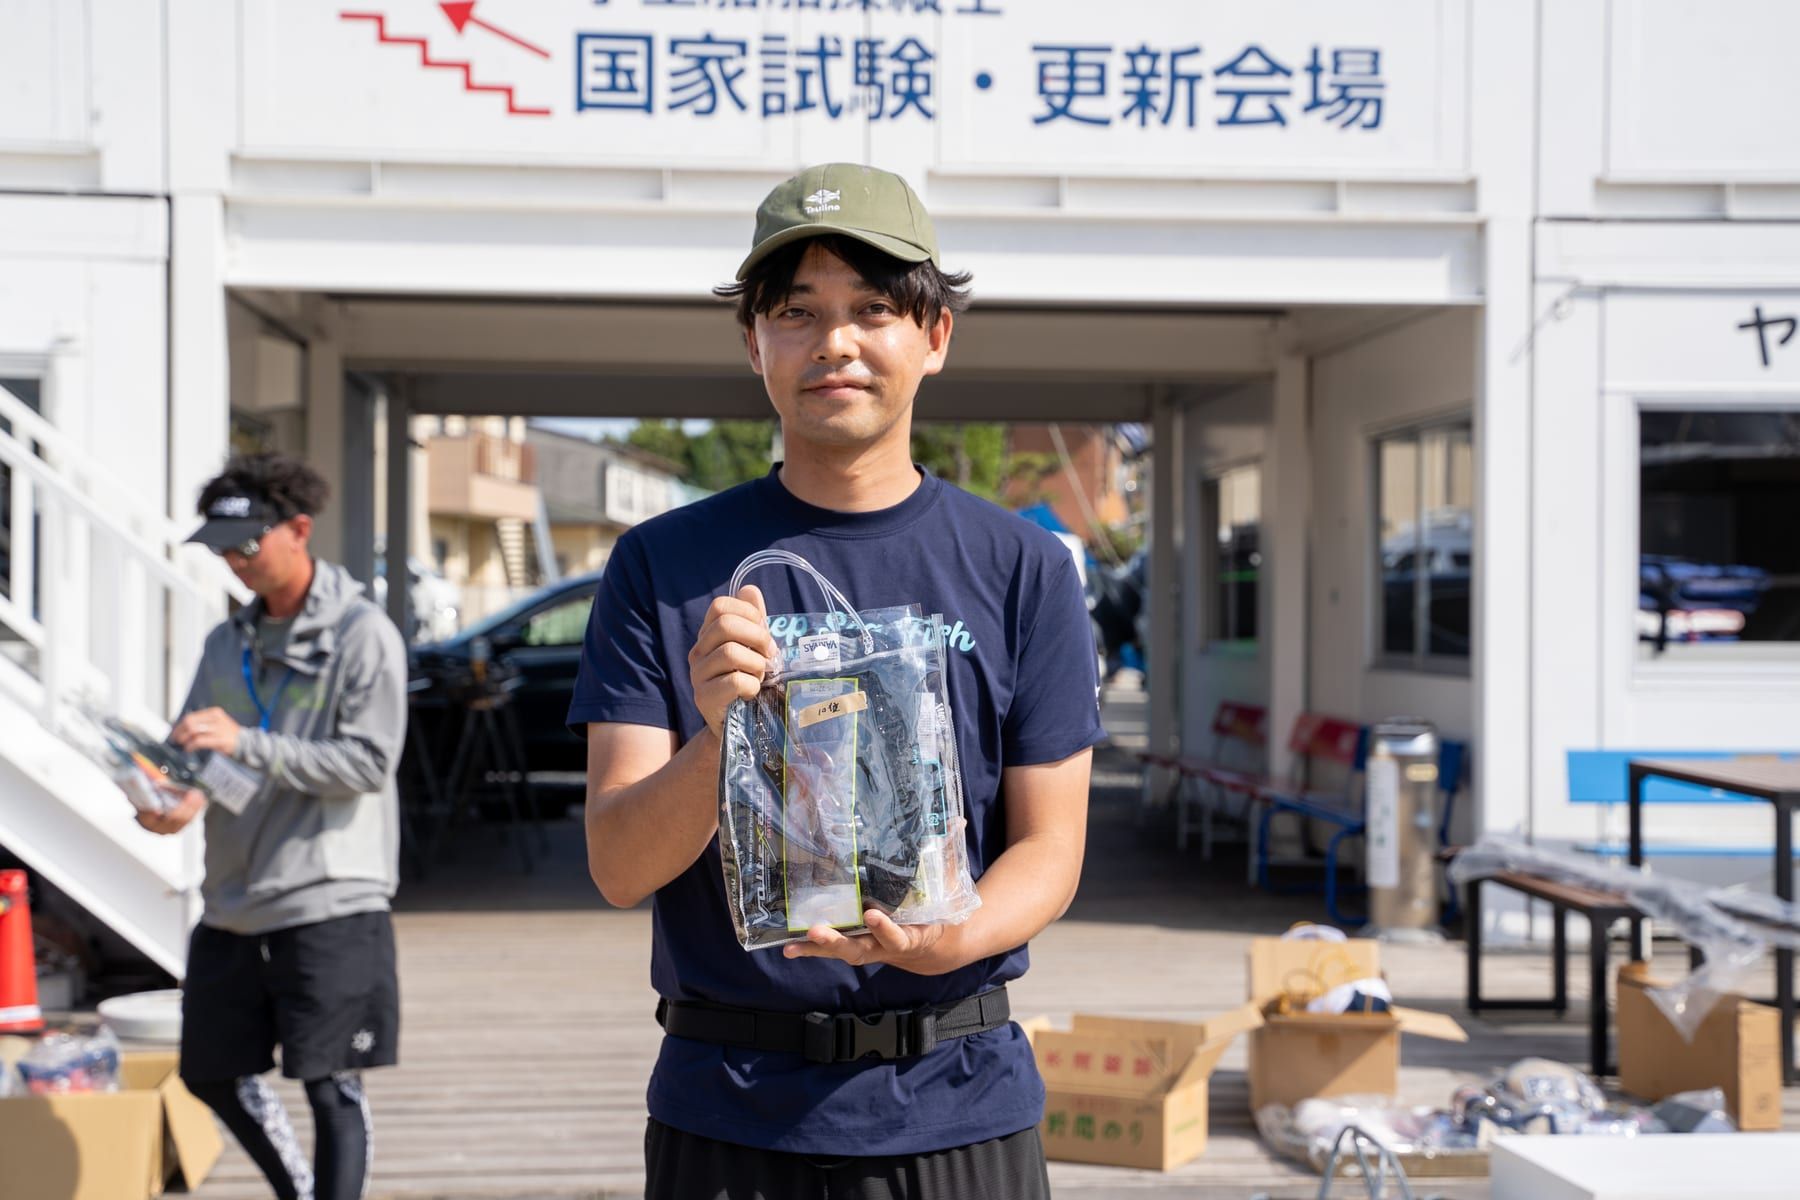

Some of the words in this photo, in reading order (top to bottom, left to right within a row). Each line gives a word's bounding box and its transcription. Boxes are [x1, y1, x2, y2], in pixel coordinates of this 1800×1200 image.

[576, 32, 1384, 129] 国家試験・更新会場
[1738, 306, 1797, 366] ヤ
[765, 615, 808, 647] ep
